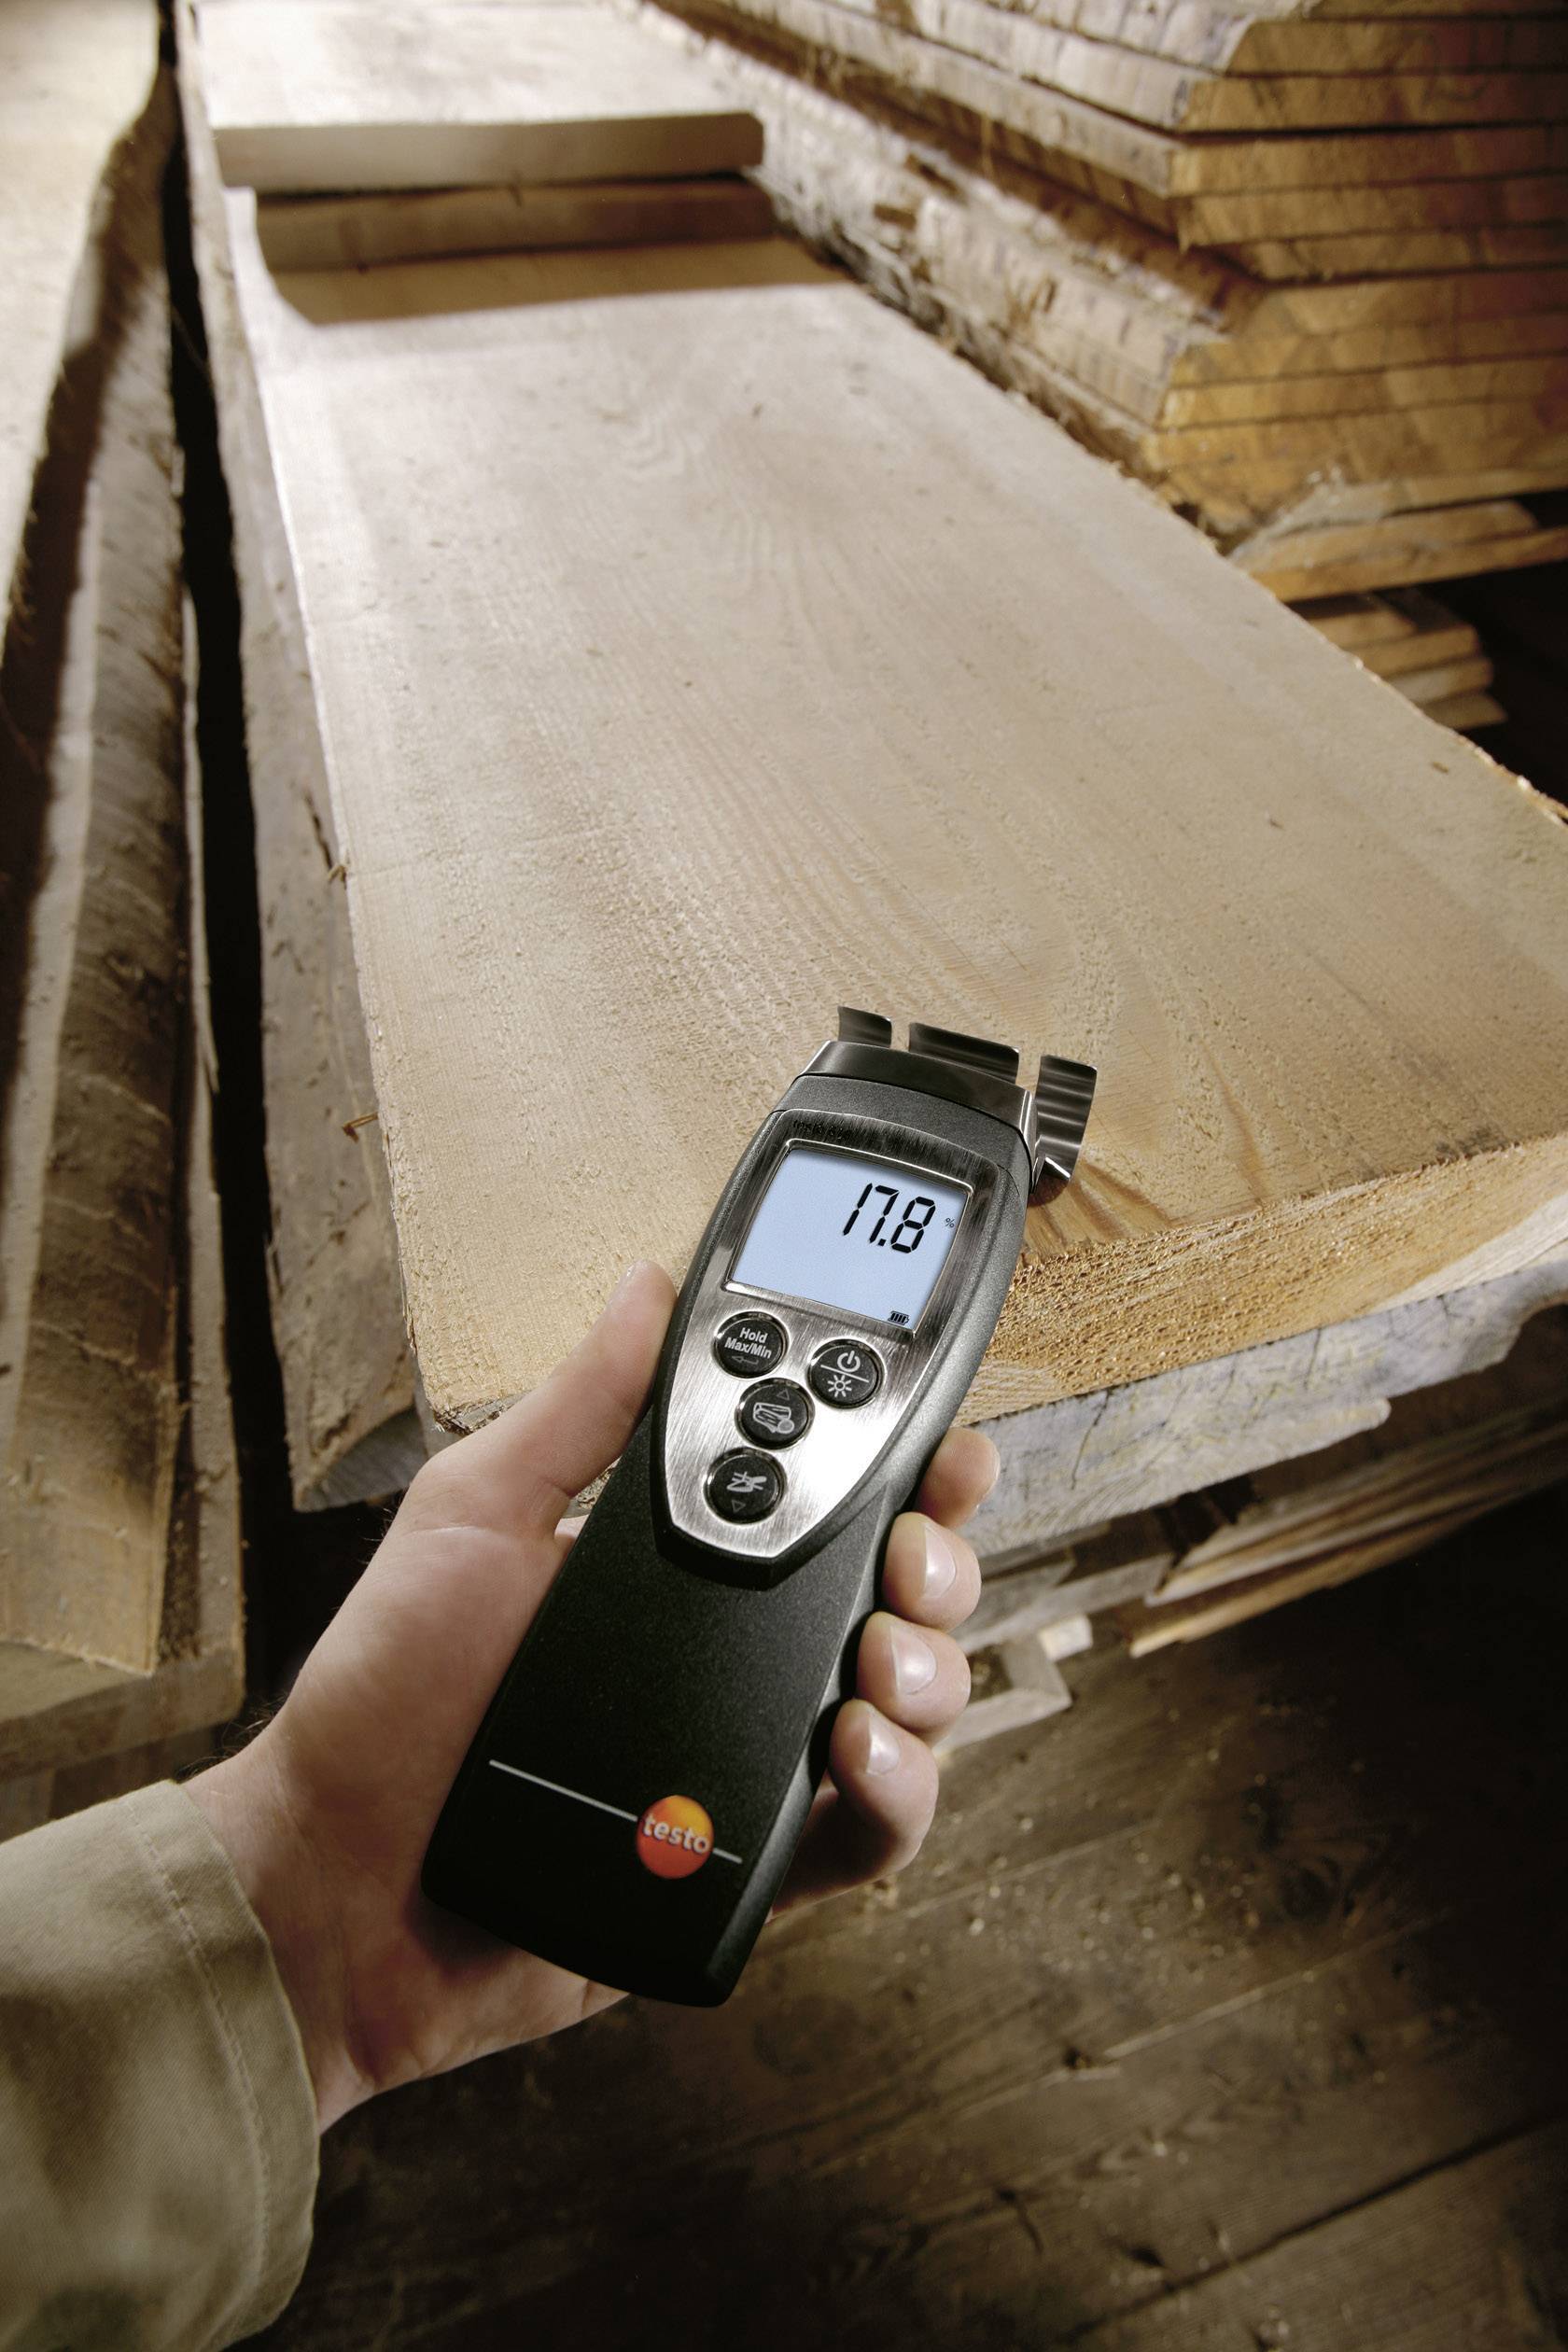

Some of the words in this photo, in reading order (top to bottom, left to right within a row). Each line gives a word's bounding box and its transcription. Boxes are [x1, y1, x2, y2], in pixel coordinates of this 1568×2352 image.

[843, 1183, 936, 1253] 17.8
[945, 1217, 955, 1228] %
[724, 1337, 772, 1359] Max/Min
[739, 1327, 768, 1344] Hold
[642, 1813, 710, 1854] testo
